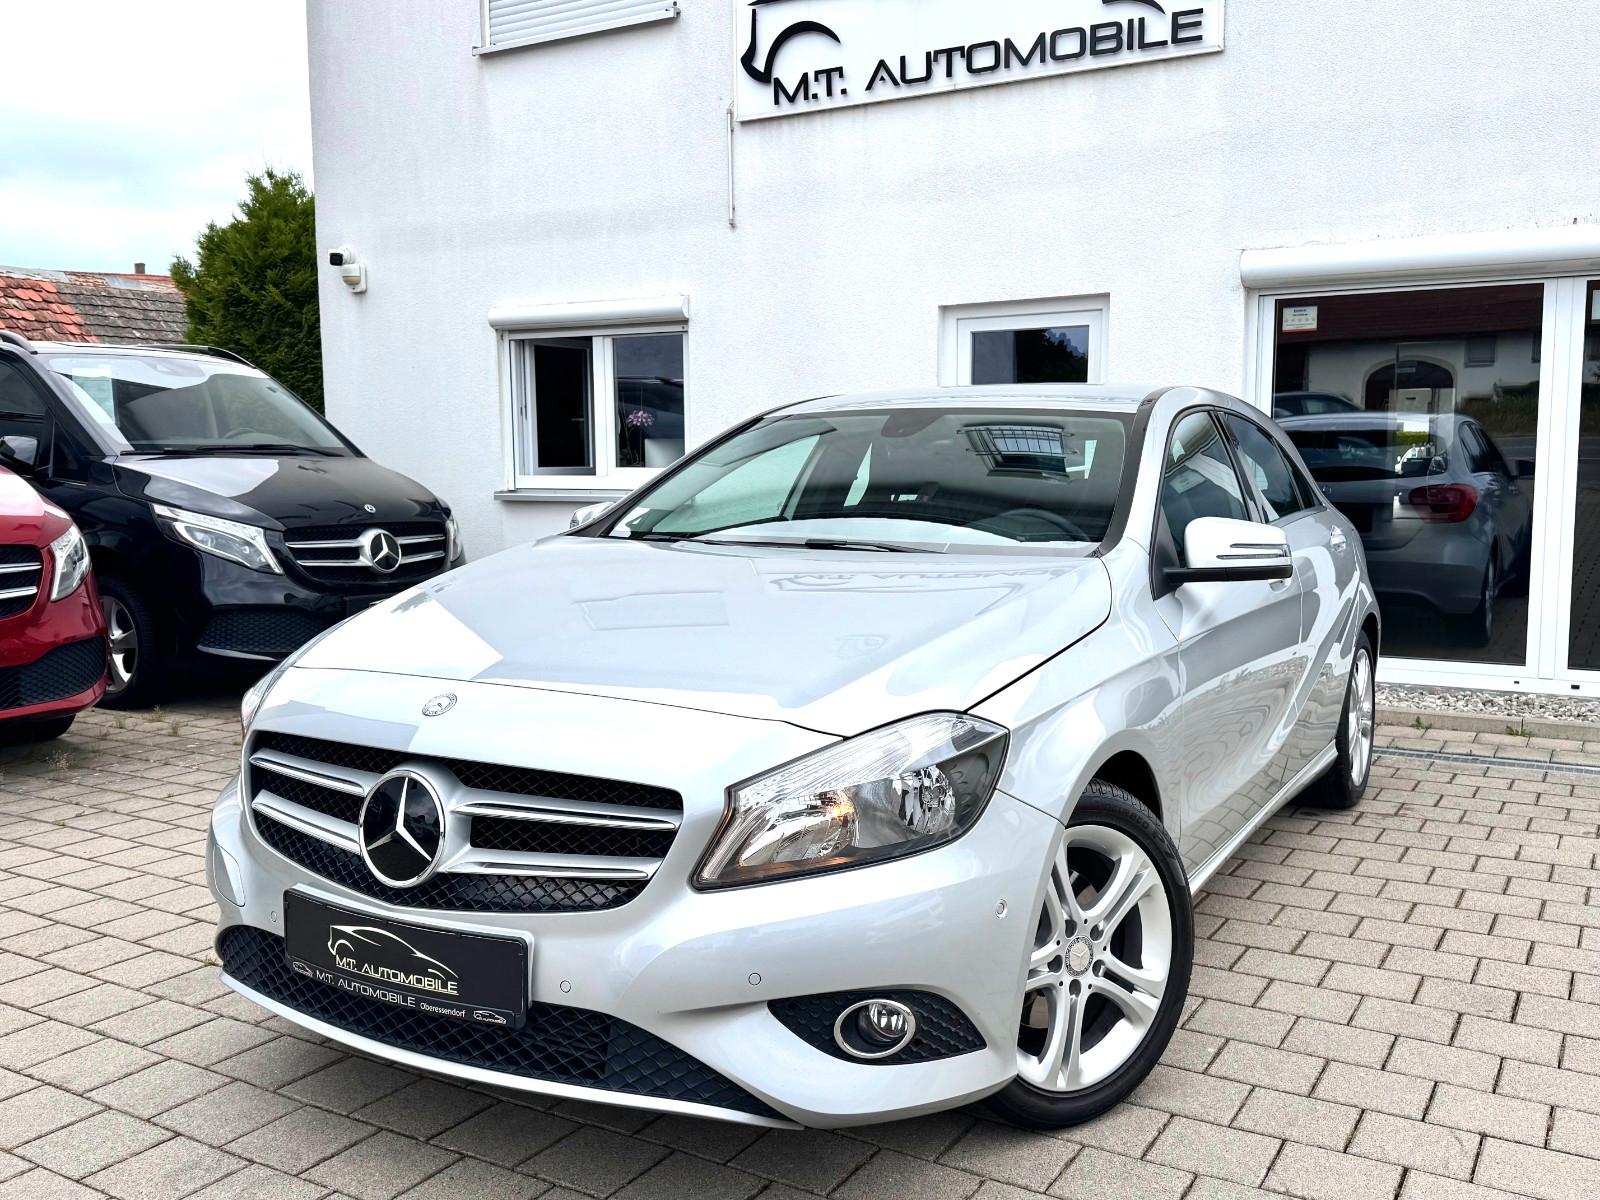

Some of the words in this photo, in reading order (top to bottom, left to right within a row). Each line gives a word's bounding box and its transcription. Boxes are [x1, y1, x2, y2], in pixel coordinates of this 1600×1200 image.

[773, 66, 848, 105] M.T.
[865, 8, 1203, 91] AUTOMOBILE
[316, 969, 335, 984] M.T.
[337, 978, 416, 1008] AUTOMOBILE
[420, 1002, 466, 1018] Oberessendorf
[336, 954, 357, 971] M.T.
[361, 963, 458, 994] AUTOMOBILE
